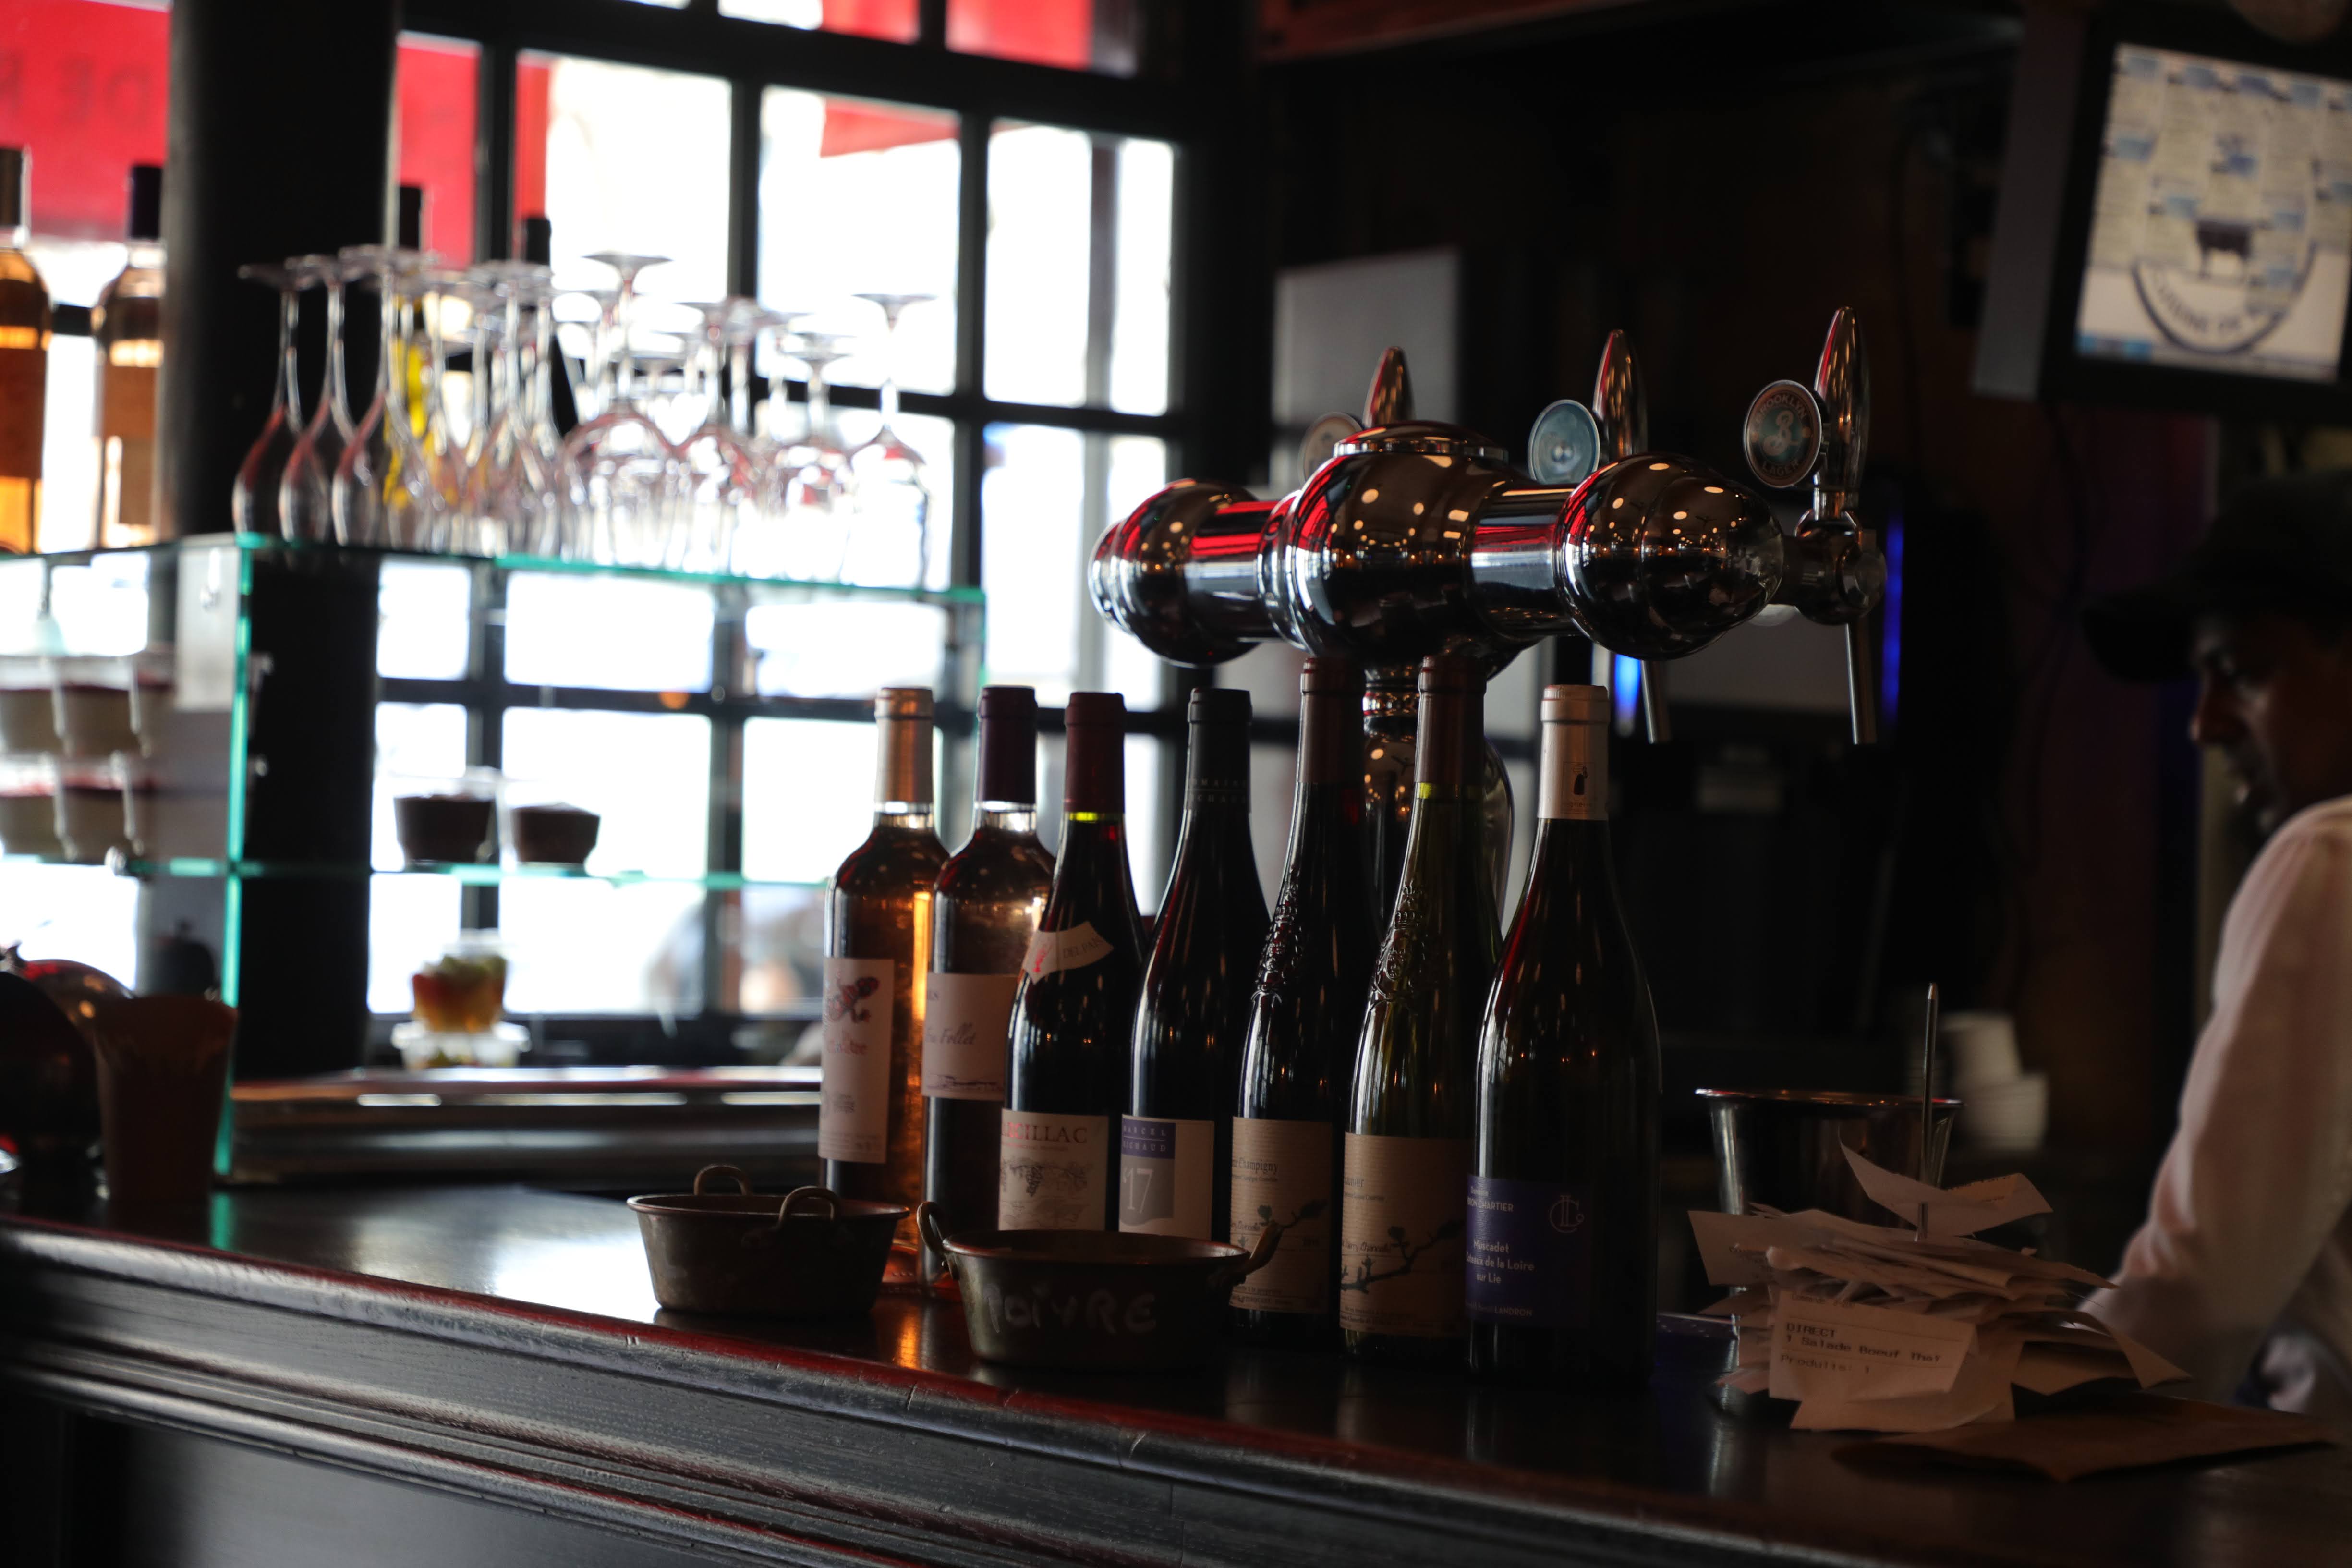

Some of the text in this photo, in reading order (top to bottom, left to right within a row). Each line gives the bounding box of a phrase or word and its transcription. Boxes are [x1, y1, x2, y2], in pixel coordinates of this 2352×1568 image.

[1755, 393, 1807, 427] BROOKLYN
[1763, 459, 1799, 476] LAGER
[1003, 1121, 1088, 1144] RCILLAC
[1473, 1239, 1510, 1253] Muscadet
[1485, 1256, 1495, 1267] de
[1497, 1257, 1505, 1268] la
[1507, 1259, 1535, 1271] Loire
[1488, 1272, 1502, 1284] Lie
[1786, 1322, 1836, 1338] DIRECT
[1801, 1337, 1852, 1352] Salade
[1859, 1345, 1900, 1359] Boeuf
